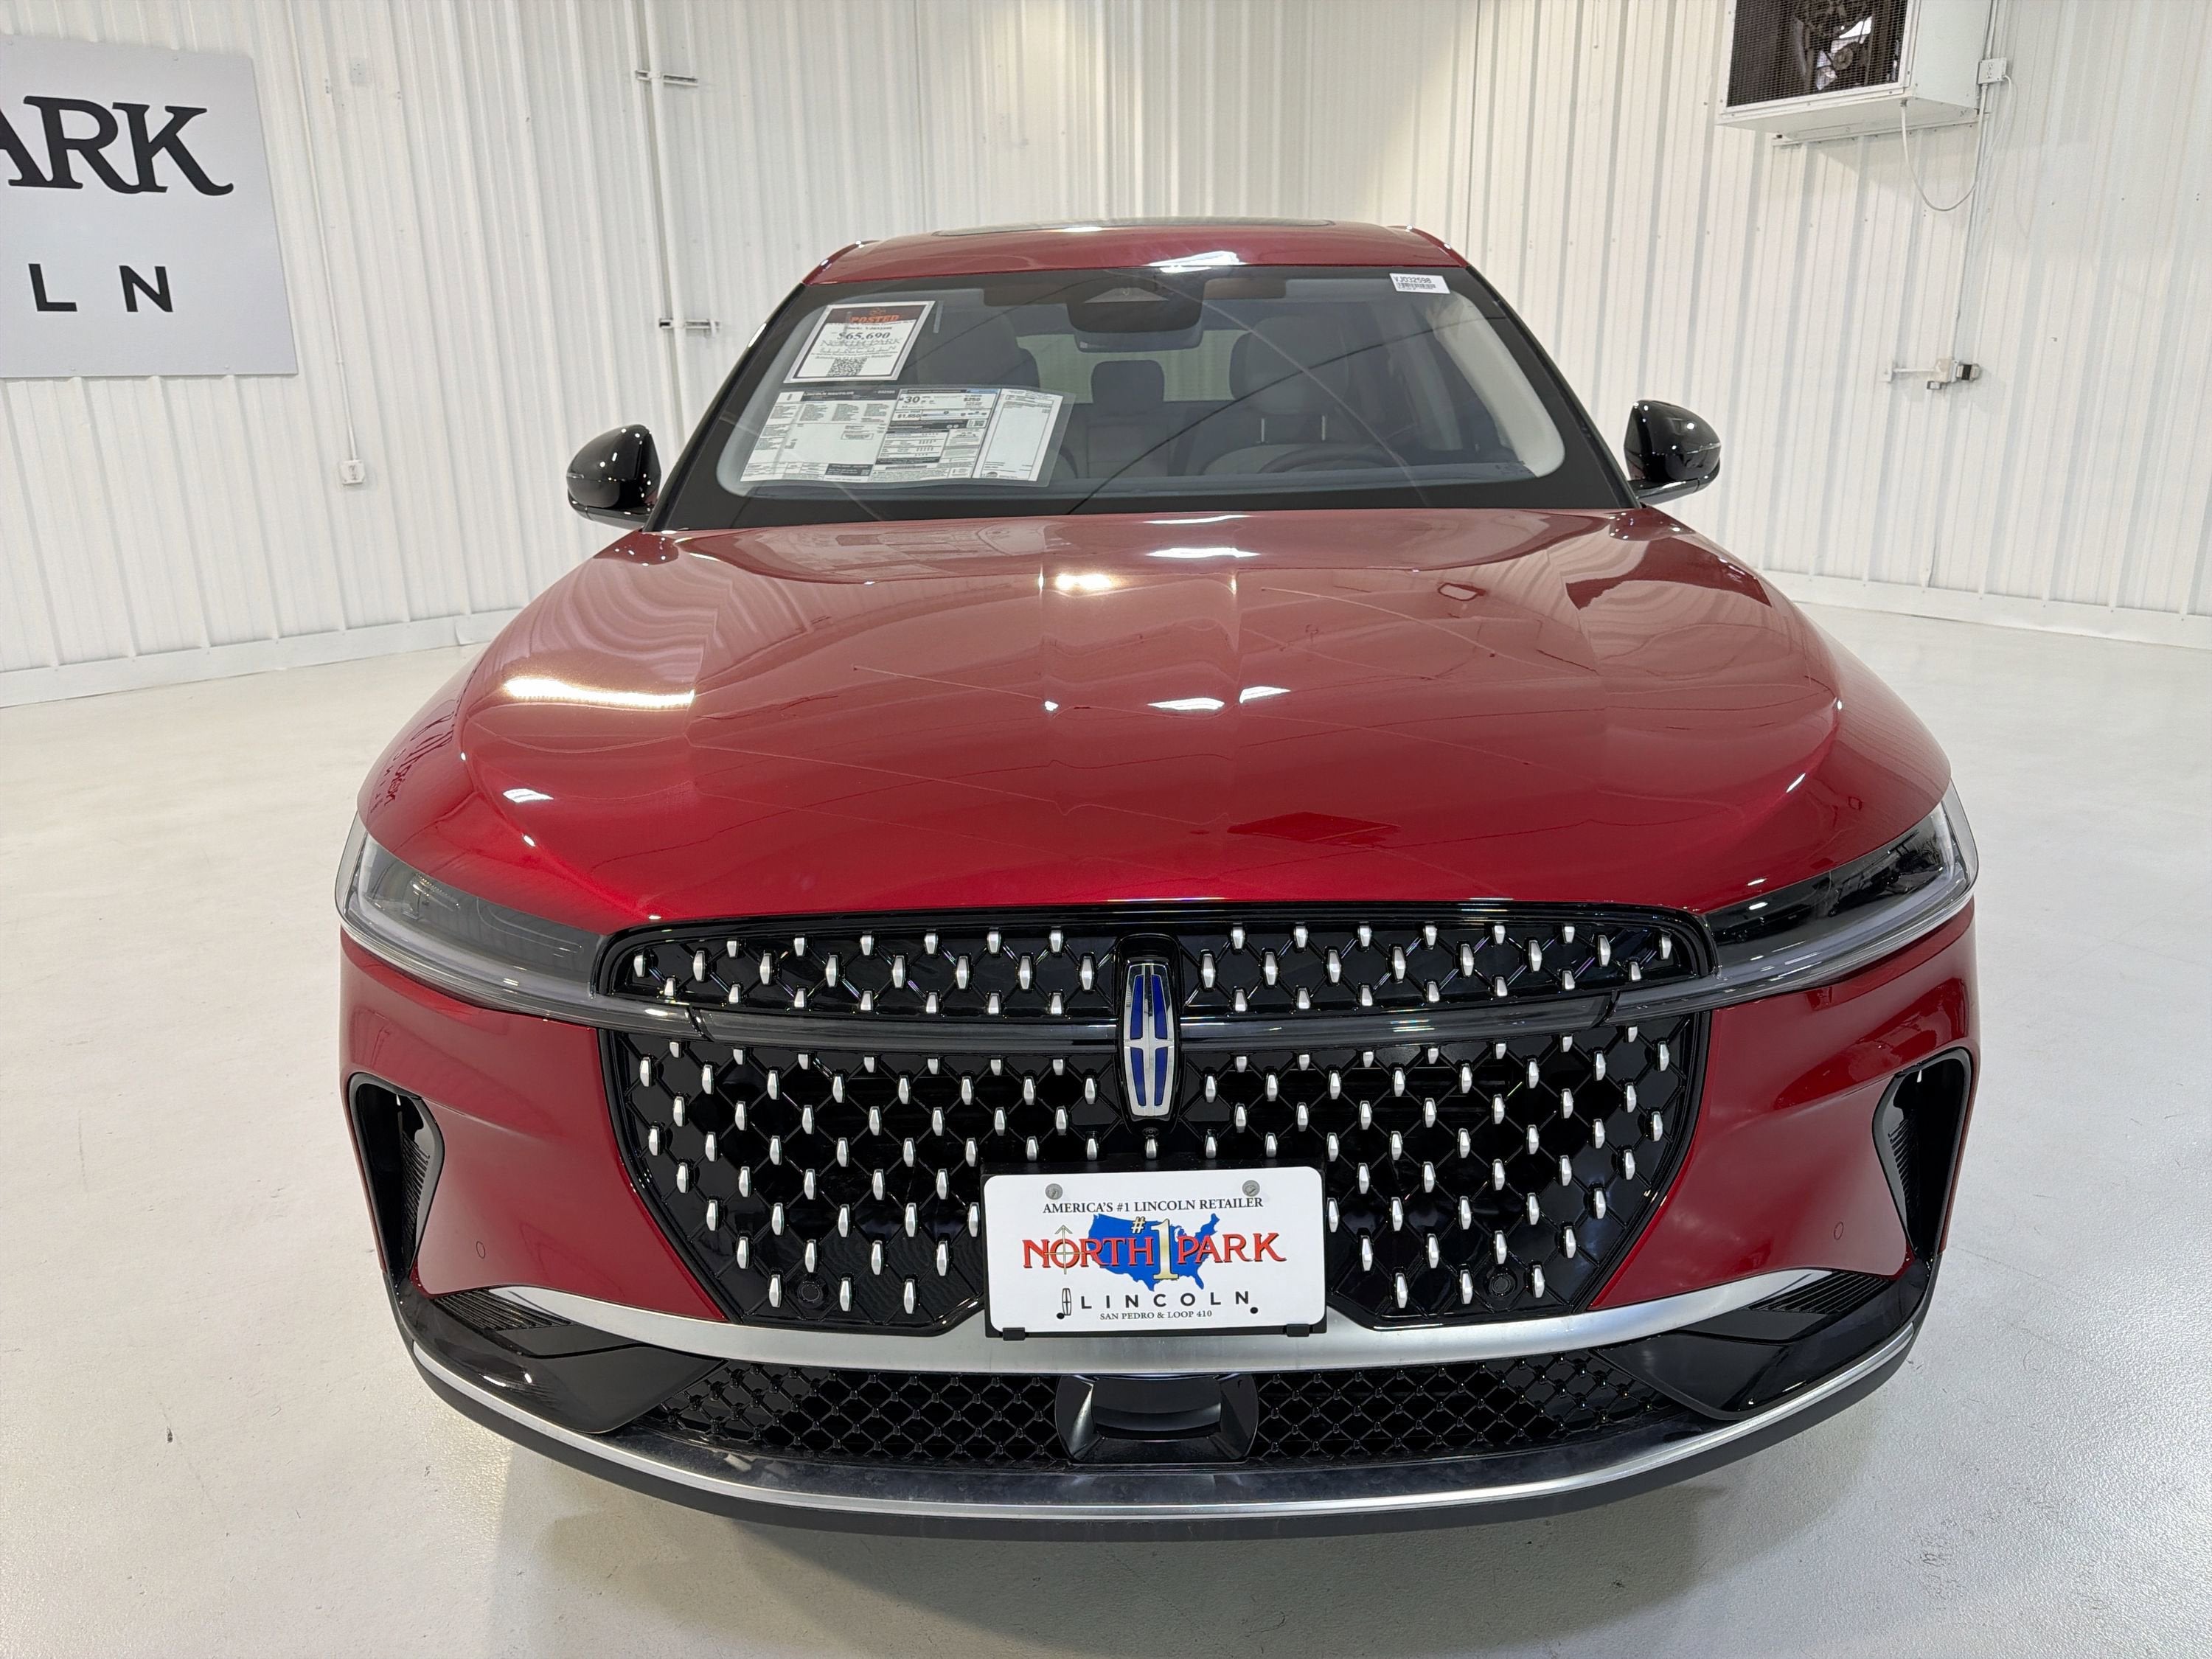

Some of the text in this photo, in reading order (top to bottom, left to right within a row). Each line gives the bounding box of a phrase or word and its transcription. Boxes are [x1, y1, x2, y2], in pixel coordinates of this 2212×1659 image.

[849, 314, 900, 324] POSTED
[1043, 1197, 1264, 1214] AMERICA'S #1 LINCOLN RETAILER
[1022, 1232, 1287, 1268] NORTH PARK
[1080, 1290, 1249, 1310] LINCOLN
[1099, 1312, 1119, 1321] SAN
[1121, 1312, 1155, 1320] PEDRO
[1167, 1310, 1194, 1318] LOOP
[1196, 1310, 1212, 1318] 410
